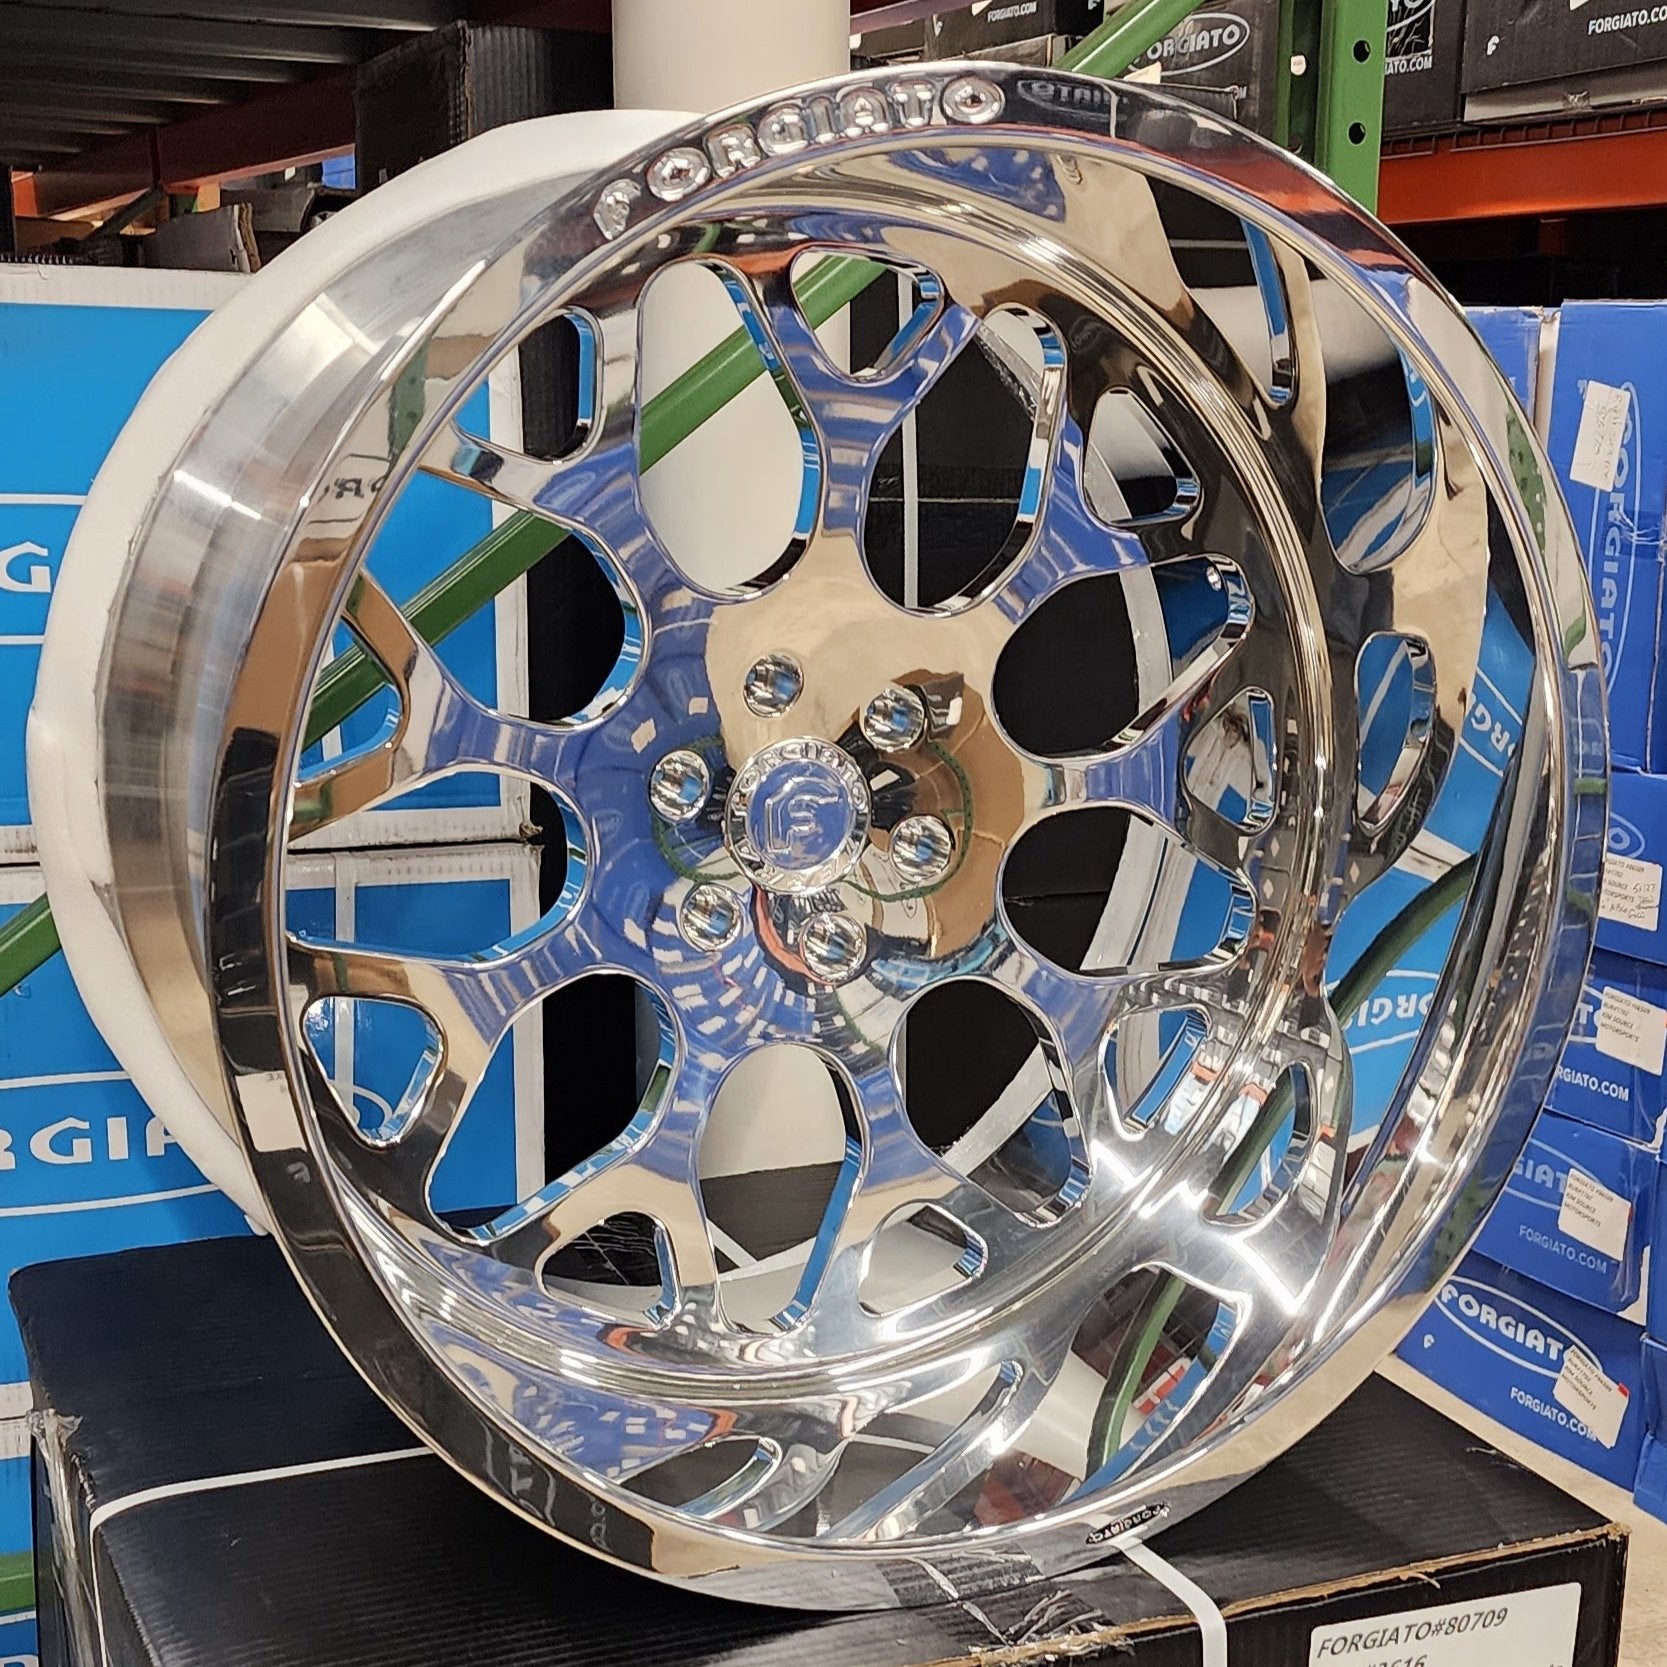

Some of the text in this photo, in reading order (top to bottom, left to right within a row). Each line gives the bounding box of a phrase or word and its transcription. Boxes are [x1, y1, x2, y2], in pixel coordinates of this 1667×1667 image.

[987, 1, 1037, 22] FORGIATO.COM
[1146, 24, 1240, 60] ORGIATO
[1519, 1224, 1607, 1275] FORGIATO.COM
[1441, 1284, 1566, 1361] FORGIAT
[1317, 1607, 1508, 1659] FORGIATO#80709
